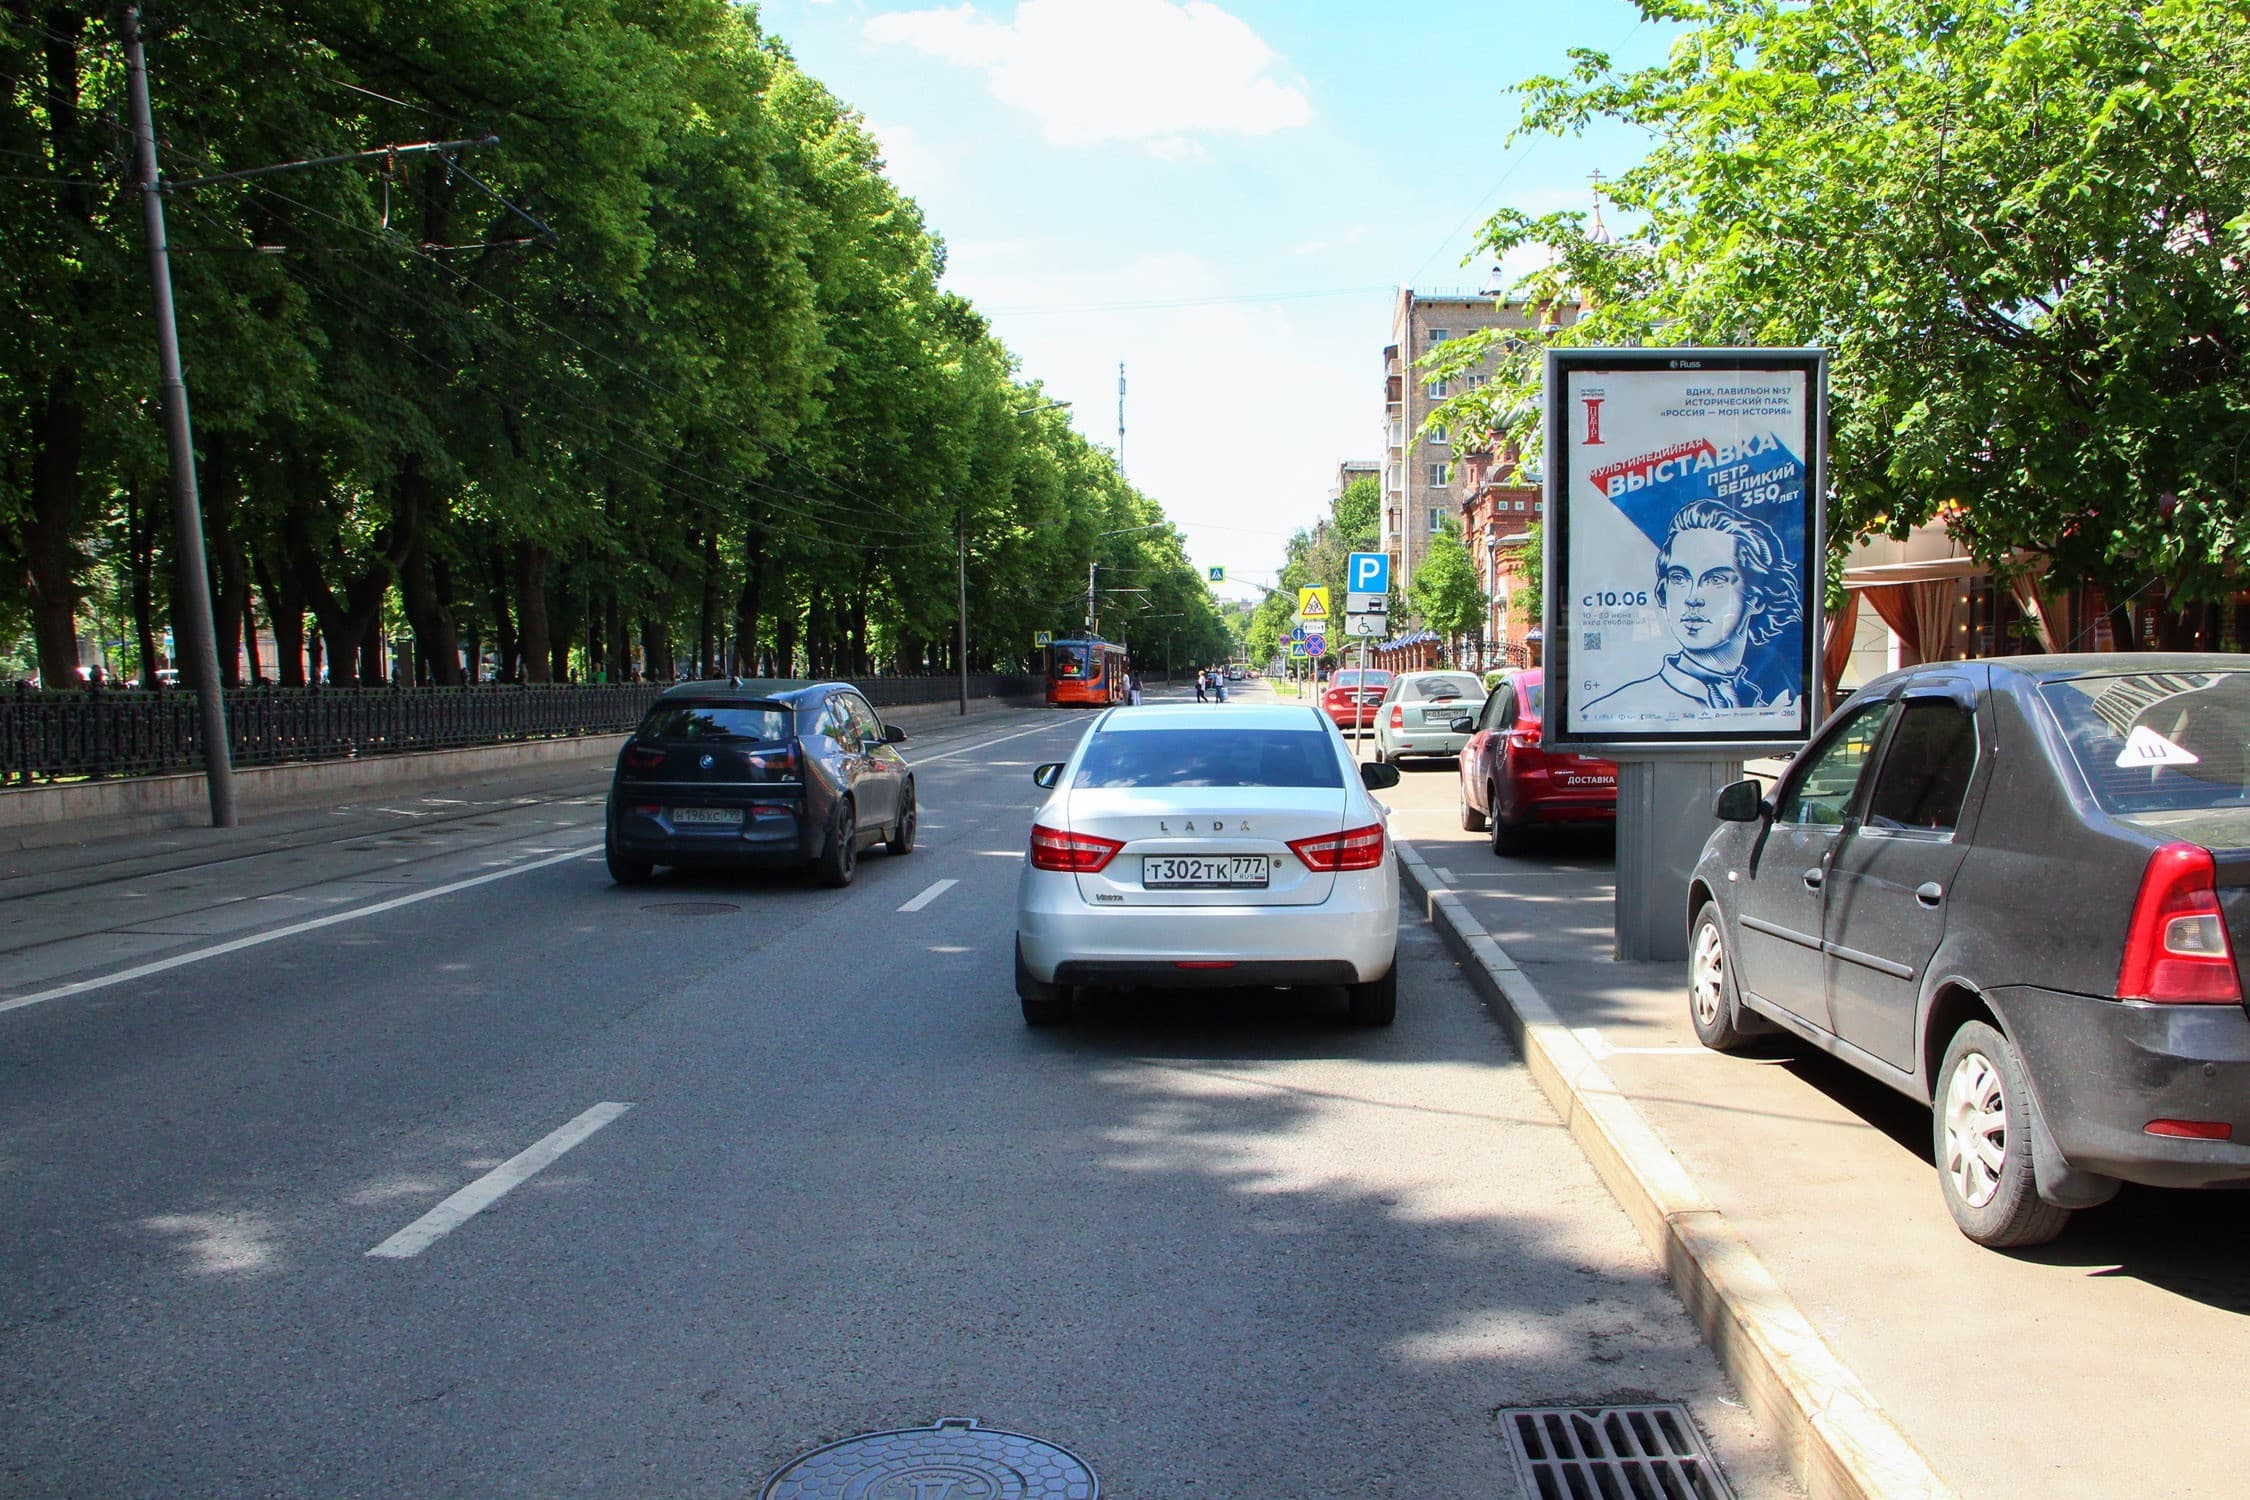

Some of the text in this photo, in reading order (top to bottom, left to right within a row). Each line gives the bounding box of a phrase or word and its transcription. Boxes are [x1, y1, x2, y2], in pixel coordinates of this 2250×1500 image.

[1680, 361, 1701, 369] Russ
[1686, 387, 1792, 396] ВДНХ, ПАВИЛЬОН №57
[1685, 396, 1790, 406] ИСТОРИЧЕСКИЙ ПАРК
[1661, 408, 1705, 417] «РОССИЯ
[1718, 408, 1740, 416] МОЯ
[1742, 408, 1792, 416] ИСТОРИЯ»
[1589, 438, 1704, 478] МУЛЬТИМЕДИЙНАЯ
[1607, 431, 1779, 499] ВЫСТАВКА
[1707, 463, 1750, 487] ПЕТР
[1717, 462, 1795, 498] ВЕЛИКИЙ
[1740, 483, 1800, 508] 350 ЛЕТ
[1359, 558, 1380, 589] P
[1596, 591, 1648, 607] 10.06
[1583, 680, 1601, 691] 6+
[1568, 776, 1615, 785] ДОСТАВКА
[1160, 821, 1250, 832] LADA
[1150, 858, 1262, 880] Т302ТК 777
